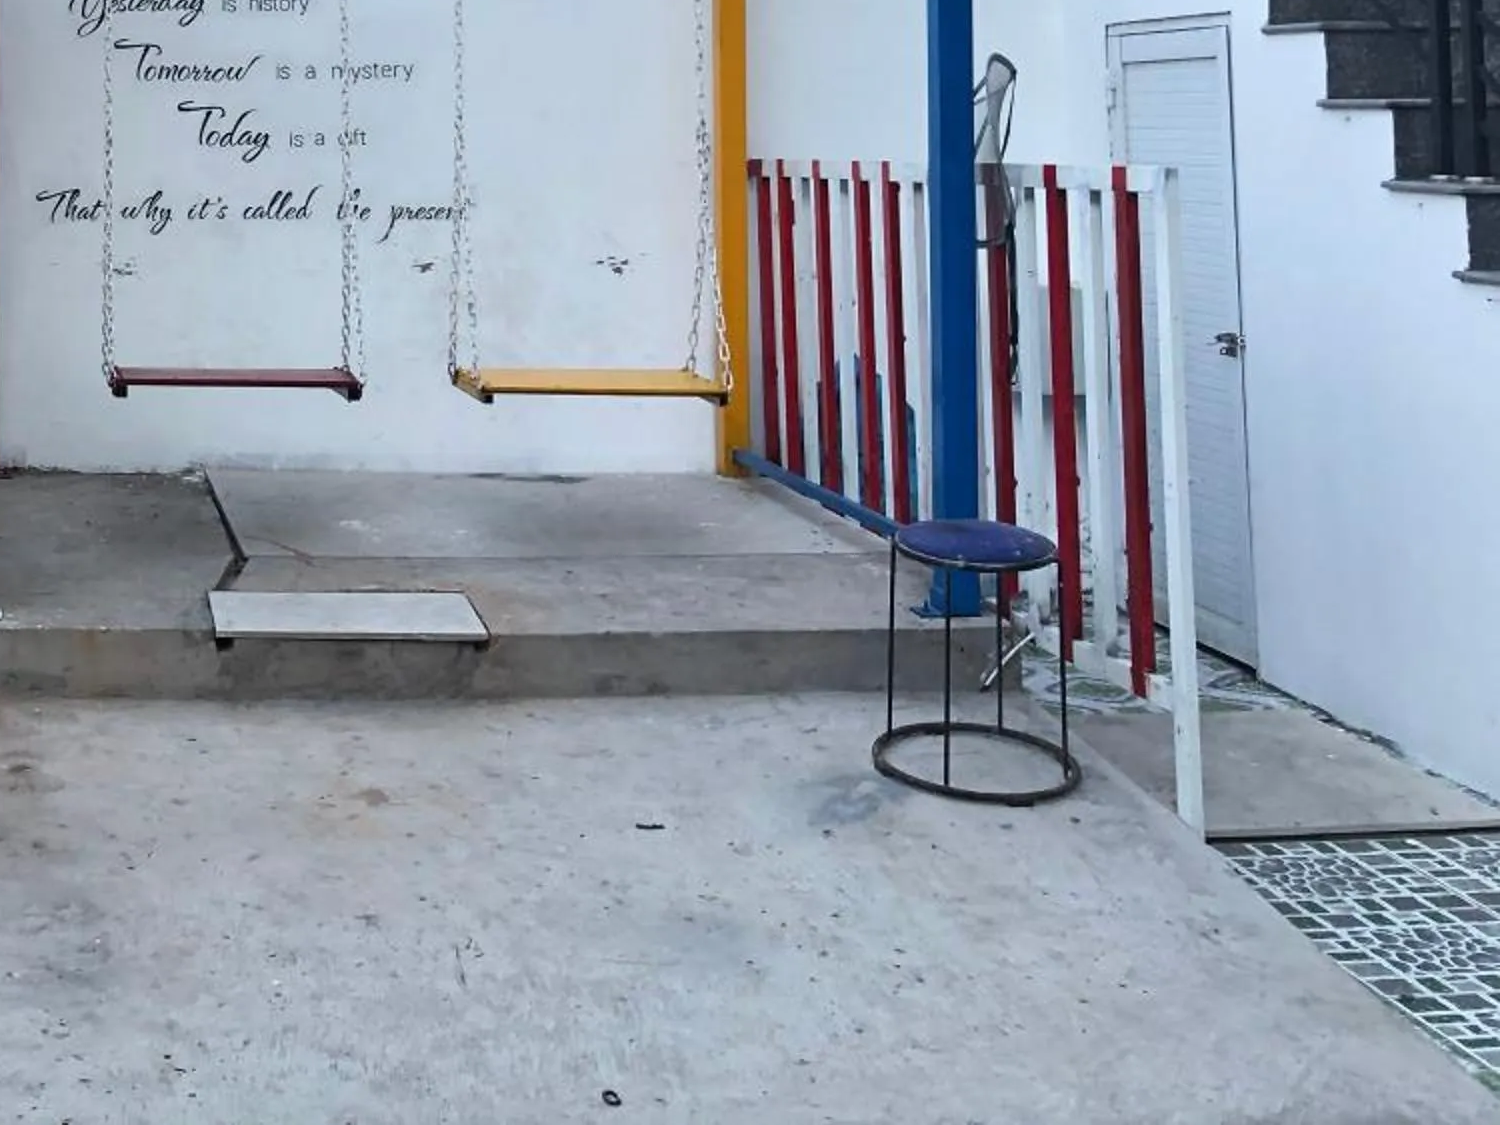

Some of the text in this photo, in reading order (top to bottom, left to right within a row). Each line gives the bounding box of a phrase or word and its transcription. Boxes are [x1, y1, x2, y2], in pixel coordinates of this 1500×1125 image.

[113, 38, 265, 83] Tomorrow
[275, 62, 291, 80] is
[305, 64, 317, 80] a
[177, 100, 271, 163] Today
[288, 130, 305, 148] is
[314, 132, 325, 146] a
[35, 188, 108, 223] That
[119, 189, 173, 235] why
[186, 196, 229, 220] it's
[242, 184, 324, 221] called
